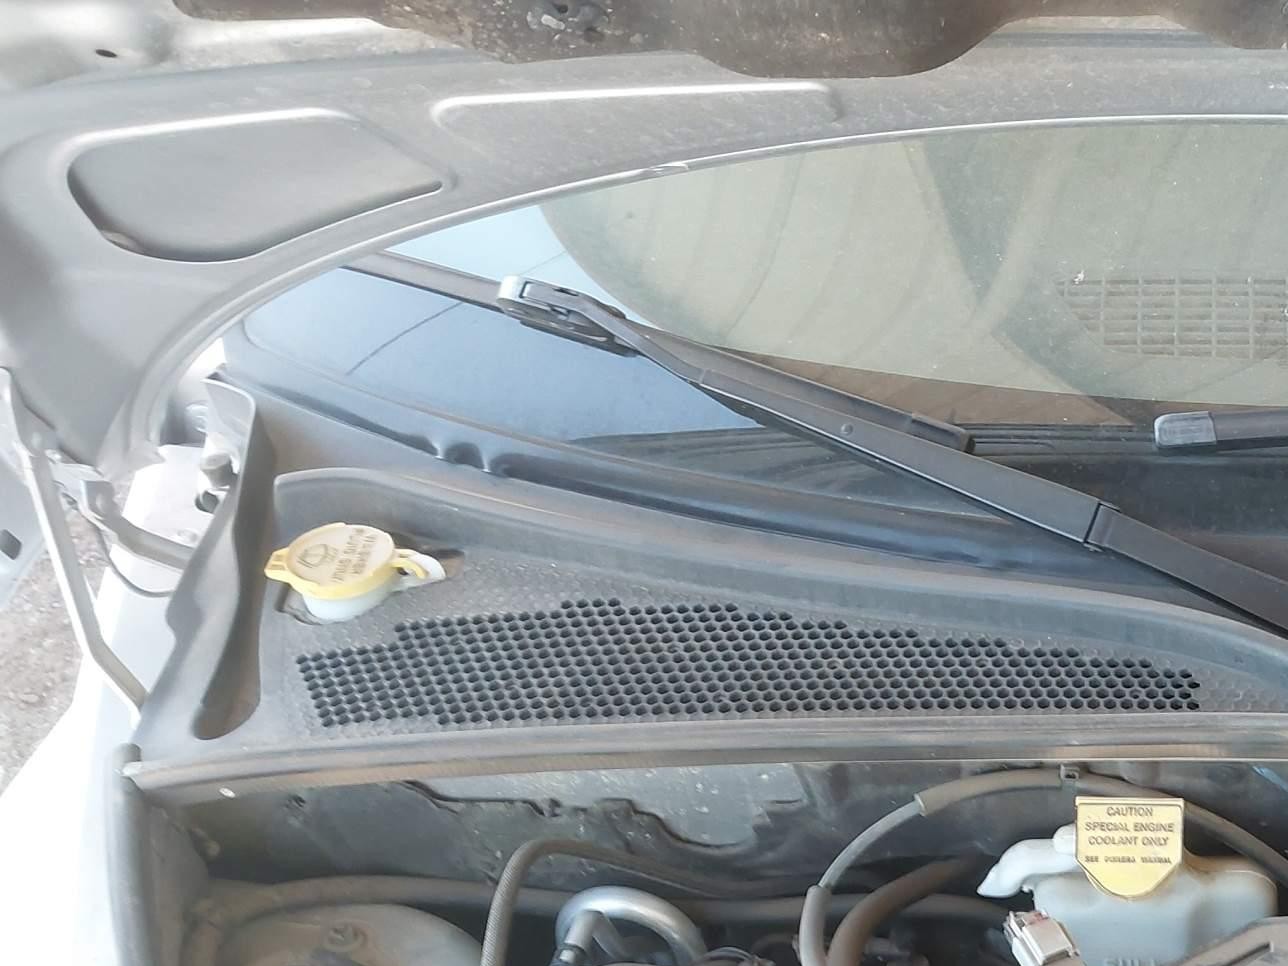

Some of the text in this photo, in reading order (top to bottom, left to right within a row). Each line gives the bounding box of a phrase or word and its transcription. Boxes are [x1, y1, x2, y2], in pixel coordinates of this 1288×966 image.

[1106, 806, 1153, 817] CAUTION
[1085, 821, 1175, 832] SPECIAL ENGINE
[1088, 836, 1169, 847] COOLANT ONLY
